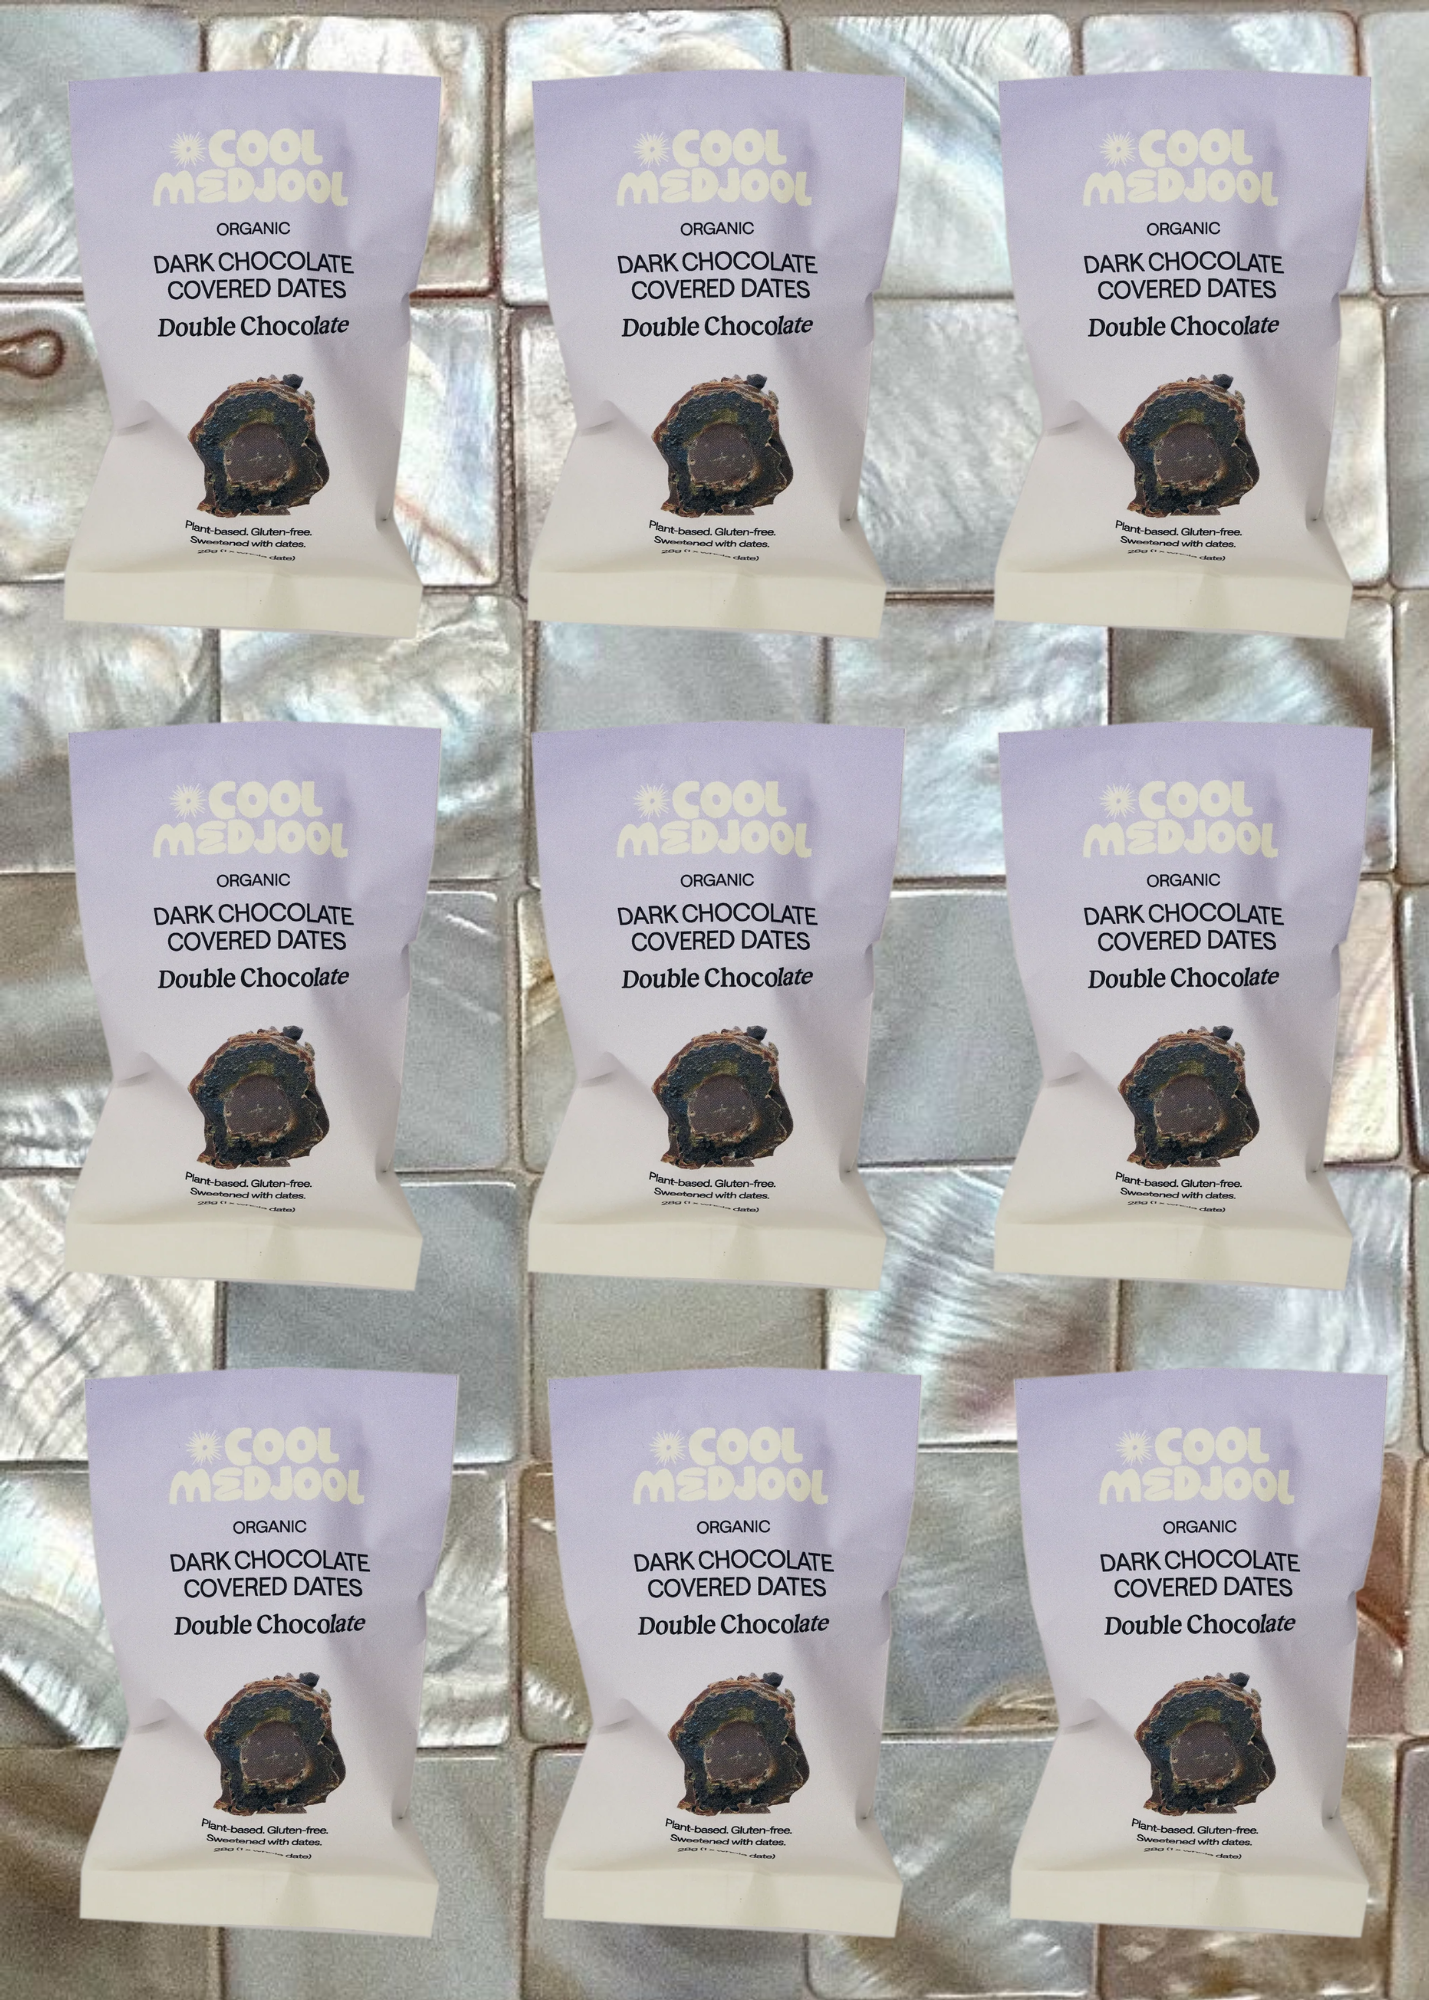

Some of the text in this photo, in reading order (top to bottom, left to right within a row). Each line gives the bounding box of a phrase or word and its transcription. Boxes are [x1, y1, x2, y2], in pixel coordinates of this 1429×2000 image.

[209, 129, 323, 168] COOL
[673, 129, 787, 168] COOL
[1139, 129, 1253, 168] COOL
[153, 168, 348, 206] MEDJOOL
[617, 168, 812, 206] MEDJOOL
[1083, 168, 1278, 206] MEDJOOL
[216, 221, 291, 237] ORGANIC
[680, 221, 755, 237] ORGANIC
[1146, 221, 1221, 237] ORGANIC
[153, 250, 355, 275] DARK CHOCOLATE
[617, 250, 819, 275] DARK CHOCOLATE
[1083, 250, 1285, 275] DARK CHOCOLATE
[167, 277, 347, 301] COVERED DATES
[631, 277, 811, 301] COVERED DATES
[1097, 277, 1277, 301] COVERED DATES
[157, 314, 350, 338] Double Chocolate
[621, 314, 814, 338] Double Chocolate
[1087, 314, 1280, 338] Double Chocolate
[184, 520, 312, 536] Plant-based. Gluten-free.
[648, 520, 776, 536] Plant-based. Gluten-free.
[1114, 520, 1242, 536] Plant-based. Gluten-free.
[190, 536, 249, 547] Sweetened
[275, 540, 306, 548] dates.
[654, 536, 713, 547] Sweetened
[739, 540, 770, 548] dates.
[1120, 536, 1179, 547] Sweetened
[1205, 540, 1236, 548] dates.
[209, 781, 323, 820] COOL
[673, 781, 787, 820] COOL
[1139, 781, 1253, 820] COOL
[153, 820, 348, 858] MEDJOOL
[617, 820, 812, 858] MEDJOOL
[1083, 820, 1278, 858] MEDJOOL
[216, 872, 291, 888] ORGANIC
[680, 872, 755, 888] ORGANIC
[1146, 872, 1221, 888] ORGANIC
[153, 902, 355, 926] DARK CHOCOLATE
[617, 902, 819, 926] DARK CHOCOLATE
[1083, 902, 1285, 926] DARK CHOCOLATE
[167, 929, 347, 952] COVERED DATES
[631, 929, 811, 952] COVERED DATES
[1097, 929, 1277, 952] COVERED DATES
[157, 966, 350, 989] Double Chocolate
[621, 966, 814, 989] Double Chocolate
[1087, 966, 1280, 989] Double Chocolate
[184, 1172, 312, 1188] Plant-based. Gluten-free.
[648, 1172, 776, 1188] Plant-based. Gluten-free.
[1114, 1172, 1242, 1188] Plant-based. Gluten-free.
[190, 1188, 249, 1199] Sweetened
[275, 1192, 306, 1200] dates.
[654, 1188, 713, 1199] Sweetened
[739, 1192, 770, 1200] dates.
[1120, 1188, 1179, 1199] Sweetened
[1205, 1192, 1236, 1200] dates.
[225, 1427, 339, 1466] COOL
[689, 1427, 803, 1466] COOL
[1155, 1427, 1269, 1466] COOL
[169, 1466, 364, 1504] MEDJOOL
[633, 1466, 828, 1504] MEDJOOL
[1099, 1466, 1294, 1504] MEDJOOL
[232, 1519, 307, 1535] ORGANIC
[696, 1519, 771, 1535] ORGANIC
[1162, 1519, 1237, 1535] ORGANIC
[169, 1548, 371, 1573] DARK CHOCOLATE
[633, 1548, 835, 1573] DARK CHOCOLATE
[1099, 1548, 1301, 1573] DARK CHOCOLATE
[183, 1576, 363, 1599] COVERED DATES
[647, 1576, 827, 1599] COVERED DATES
[1113, 1576, 1294, 1599] COVERED DATES
[173, 1613, 367, 1636] Double Chocolate
[637, 1613, 830, 1636] Double Chocolate
[1104, 1613, 1297, 1636] Double Chocolate
[200, 1818, 328, 1834] Plant-based. Gluten-free.
[664, 1818, 792, 1834] Plant-based. Gluten-free.
[1130, 1818, 1258, 1834] Plant-based. Gluten-free.
[206, 1834, 265, 1845] Sweetened
[291, 1838, 322, 1846] dates.
[670, 1834, 729, 1845] Sweetened
[755, 1838, 786, 1846] dates.
[1136, 1834, 1195, 1845] Sweetened
[1221, 1838, 1252, 1846] dates.
